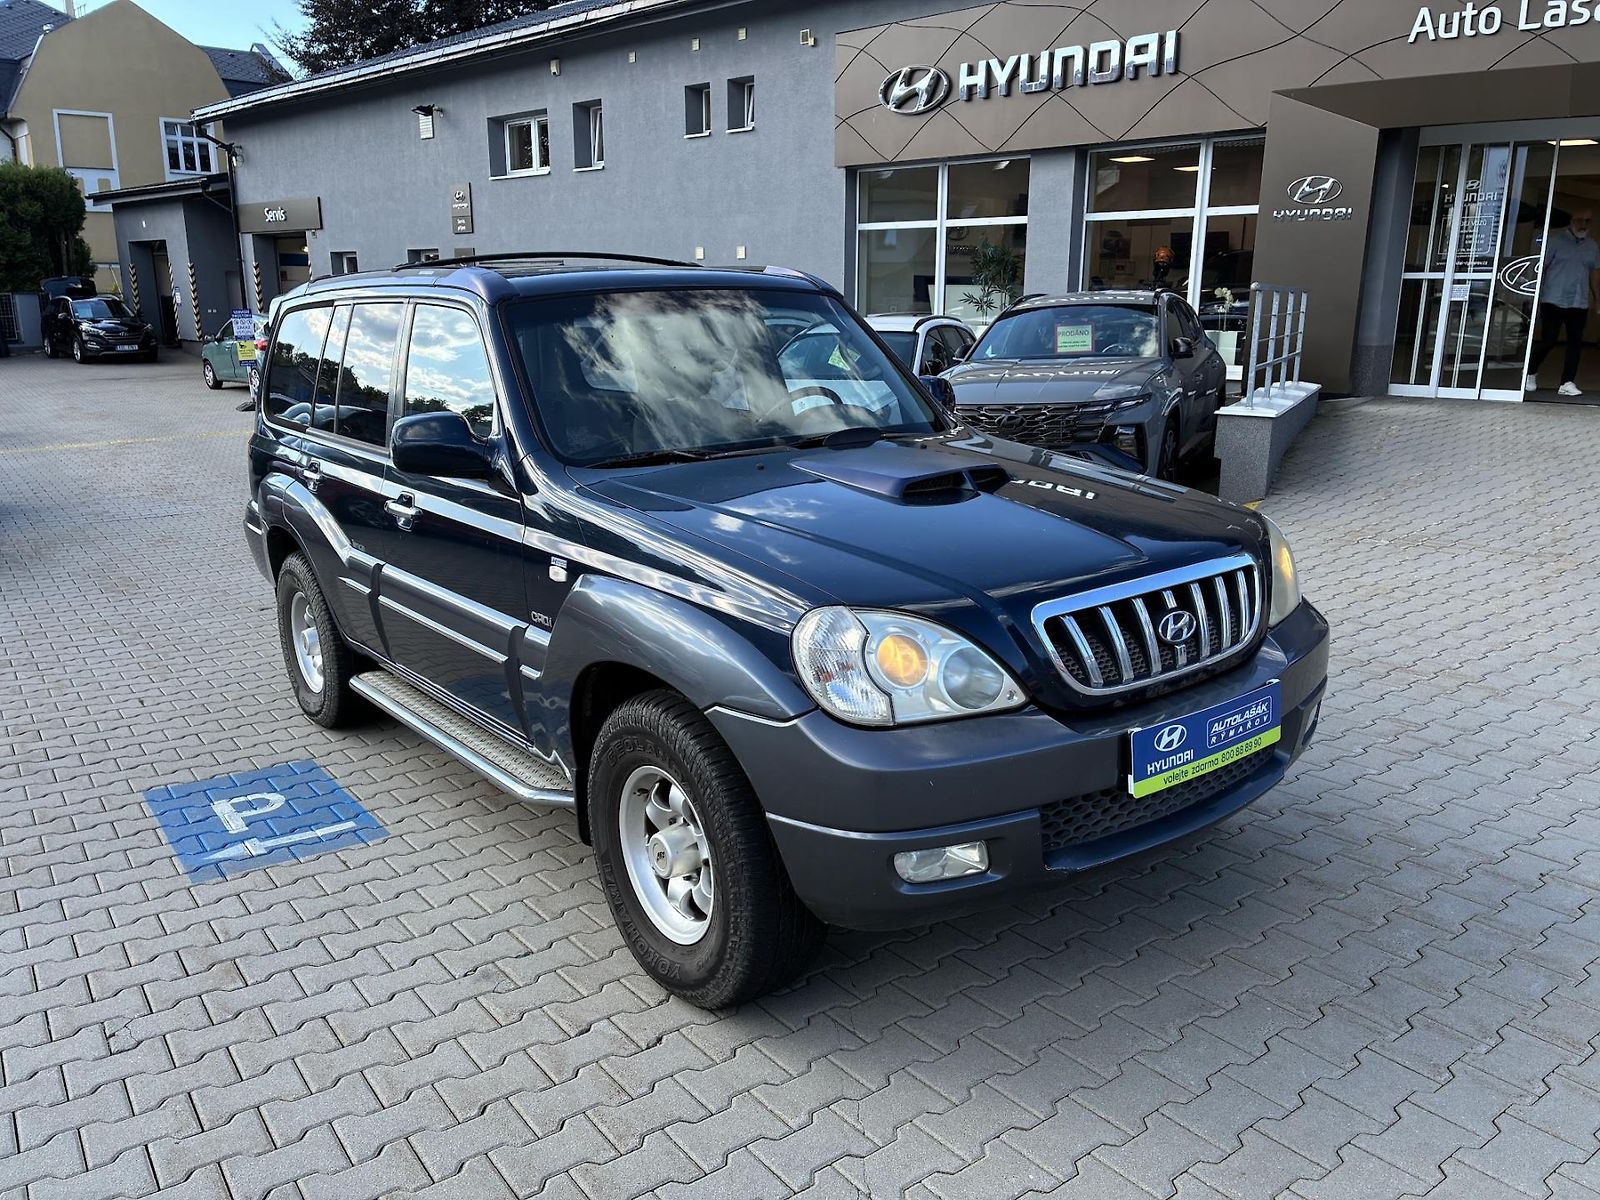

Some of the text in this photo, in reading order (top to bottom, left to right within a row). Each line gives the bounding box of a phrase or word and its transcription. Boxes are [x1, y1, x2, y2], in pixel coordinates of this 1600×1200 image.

[1408, 0, 1600, 43] Auto Las
[958, 29, 1180, 101] HYUNDAI
[263, 206, 287, 222] Servis
[1445, 192, 1497, 203] HUNDAI
[1273, 207, 1353, 222] HYUNDAI
[1210, 701, 1269, 734] AUTOLAŠÁK
[1147, 749, 1194, 776] HYUNDAI
[1163, 768, 1189, 785] volejte
[1191, 757, 1219, 775] zdarma
[1221, 749, 1236, 763] 800
[1235, 745, 1244, 757] 88
[1253, 736, 1262, 749] 90
[212, 792, 286, 834] P
